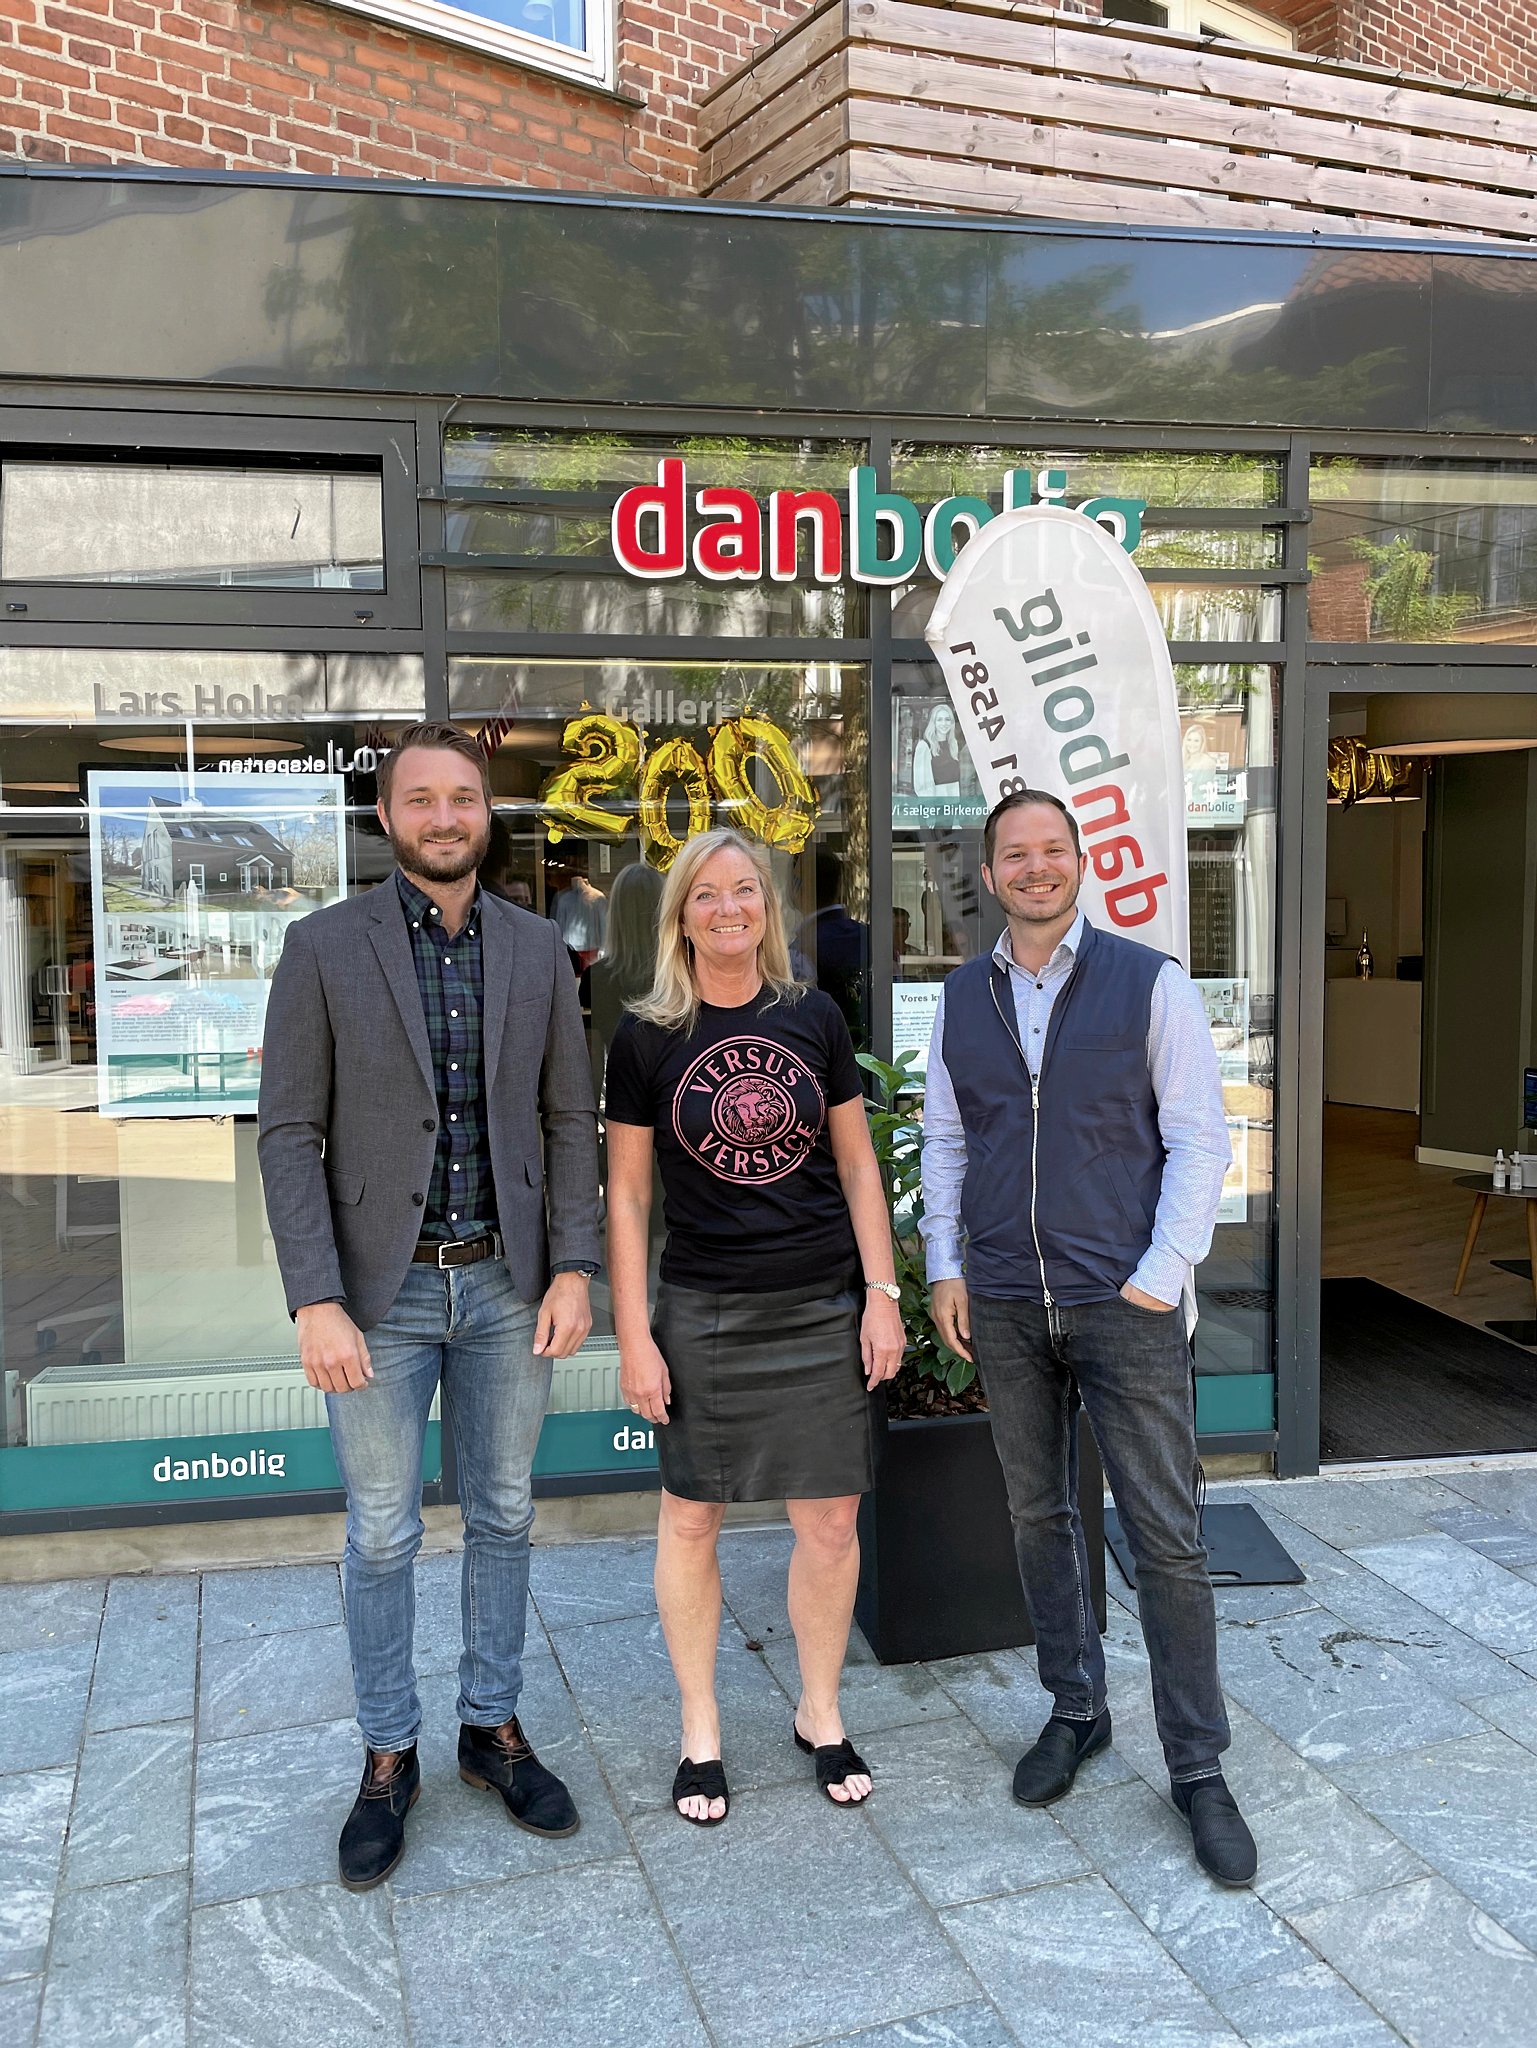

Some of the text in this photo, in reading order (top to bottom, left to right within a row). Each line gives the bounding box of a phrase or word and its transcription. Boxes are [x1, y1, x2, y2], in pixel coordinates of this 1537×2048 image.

[94, 683, 303, 719] Lars Holm
[606, 690, 723, 726] Galleri
[537, 715, 821, 874] 200
[903, 804, 940, 819] sælger
[943, 804, 989, 816] Birkerød
[1188, 802, 1235, 813] danbolig
[901, 994, 928, 1003] Vores
[689, 1047, 802, 1093] VERSUS
[698, 1120, 815, 1174] VERSACE
[153, 1449, 286, 1482] danbolig
